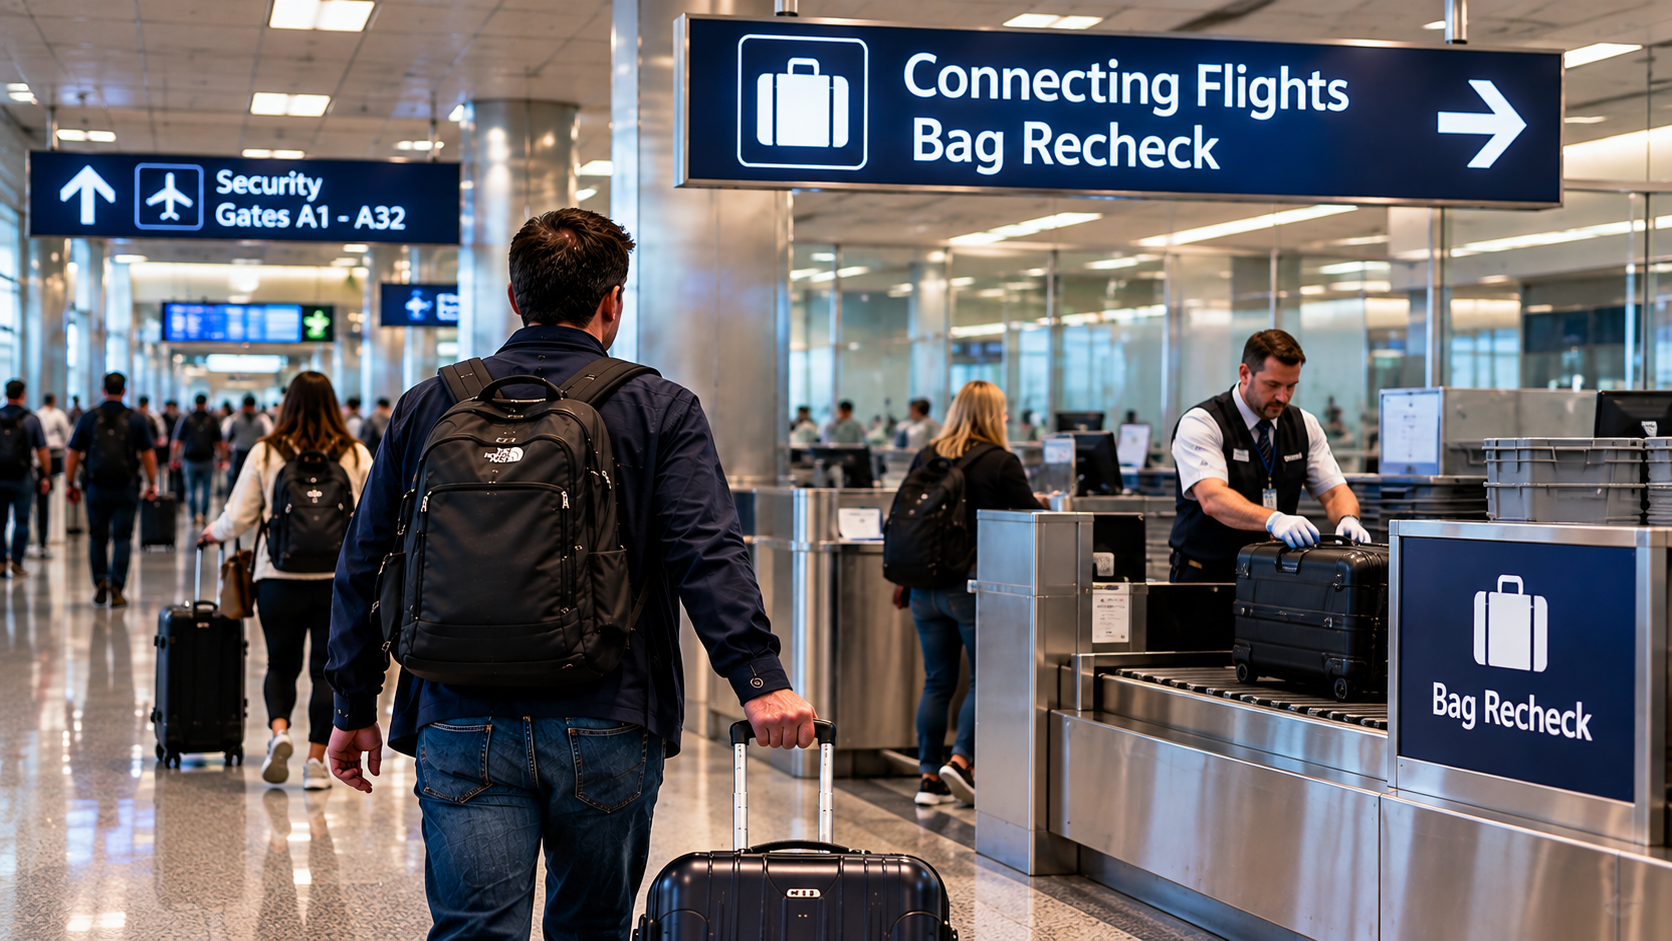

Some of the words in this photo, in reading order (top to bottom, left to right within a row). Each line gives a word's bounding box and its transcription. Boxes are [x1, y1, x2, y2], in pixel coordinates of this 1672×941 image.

[903, 52, 1179, 117] Connecting
[1197, 63, 1350, 121] Flights
[913, 117, 1004, 176] Bag
[1023, 120, 1221, 170] Recheck
[216, 169, 323, 202] Security
[215, 202, 291, 228] Gates
[296, 204, 329, 229] A1
[354, 205, 406, 231] A32
[1432, 681, 1476, 731] Bag
[1484, 689, 1593, 742] Recheck
